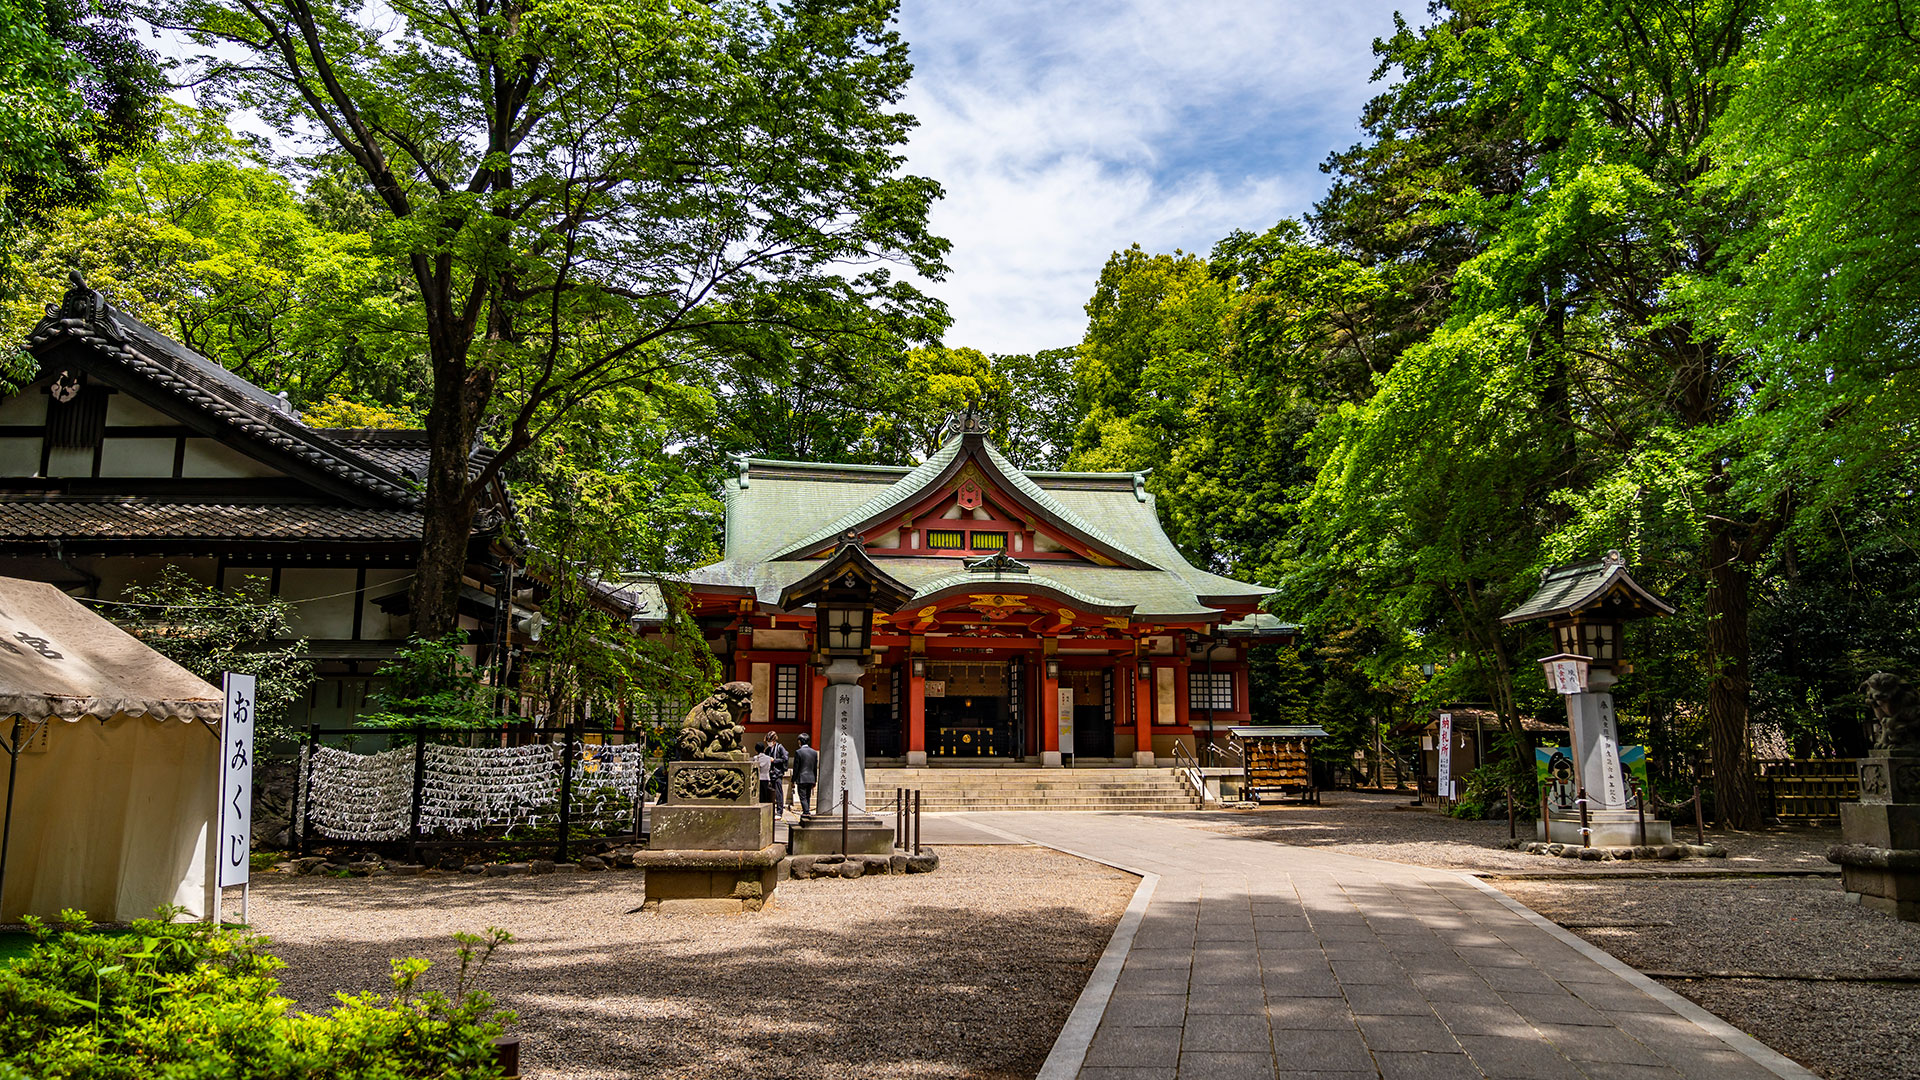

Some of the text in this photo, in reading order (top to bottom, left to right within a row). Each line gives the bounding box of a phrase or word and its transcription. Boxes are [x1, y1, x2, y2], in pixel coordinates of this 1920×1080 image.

[230, 690, 250, 867] おみくじ
[1441, 717, 1449, 757] 納札所
